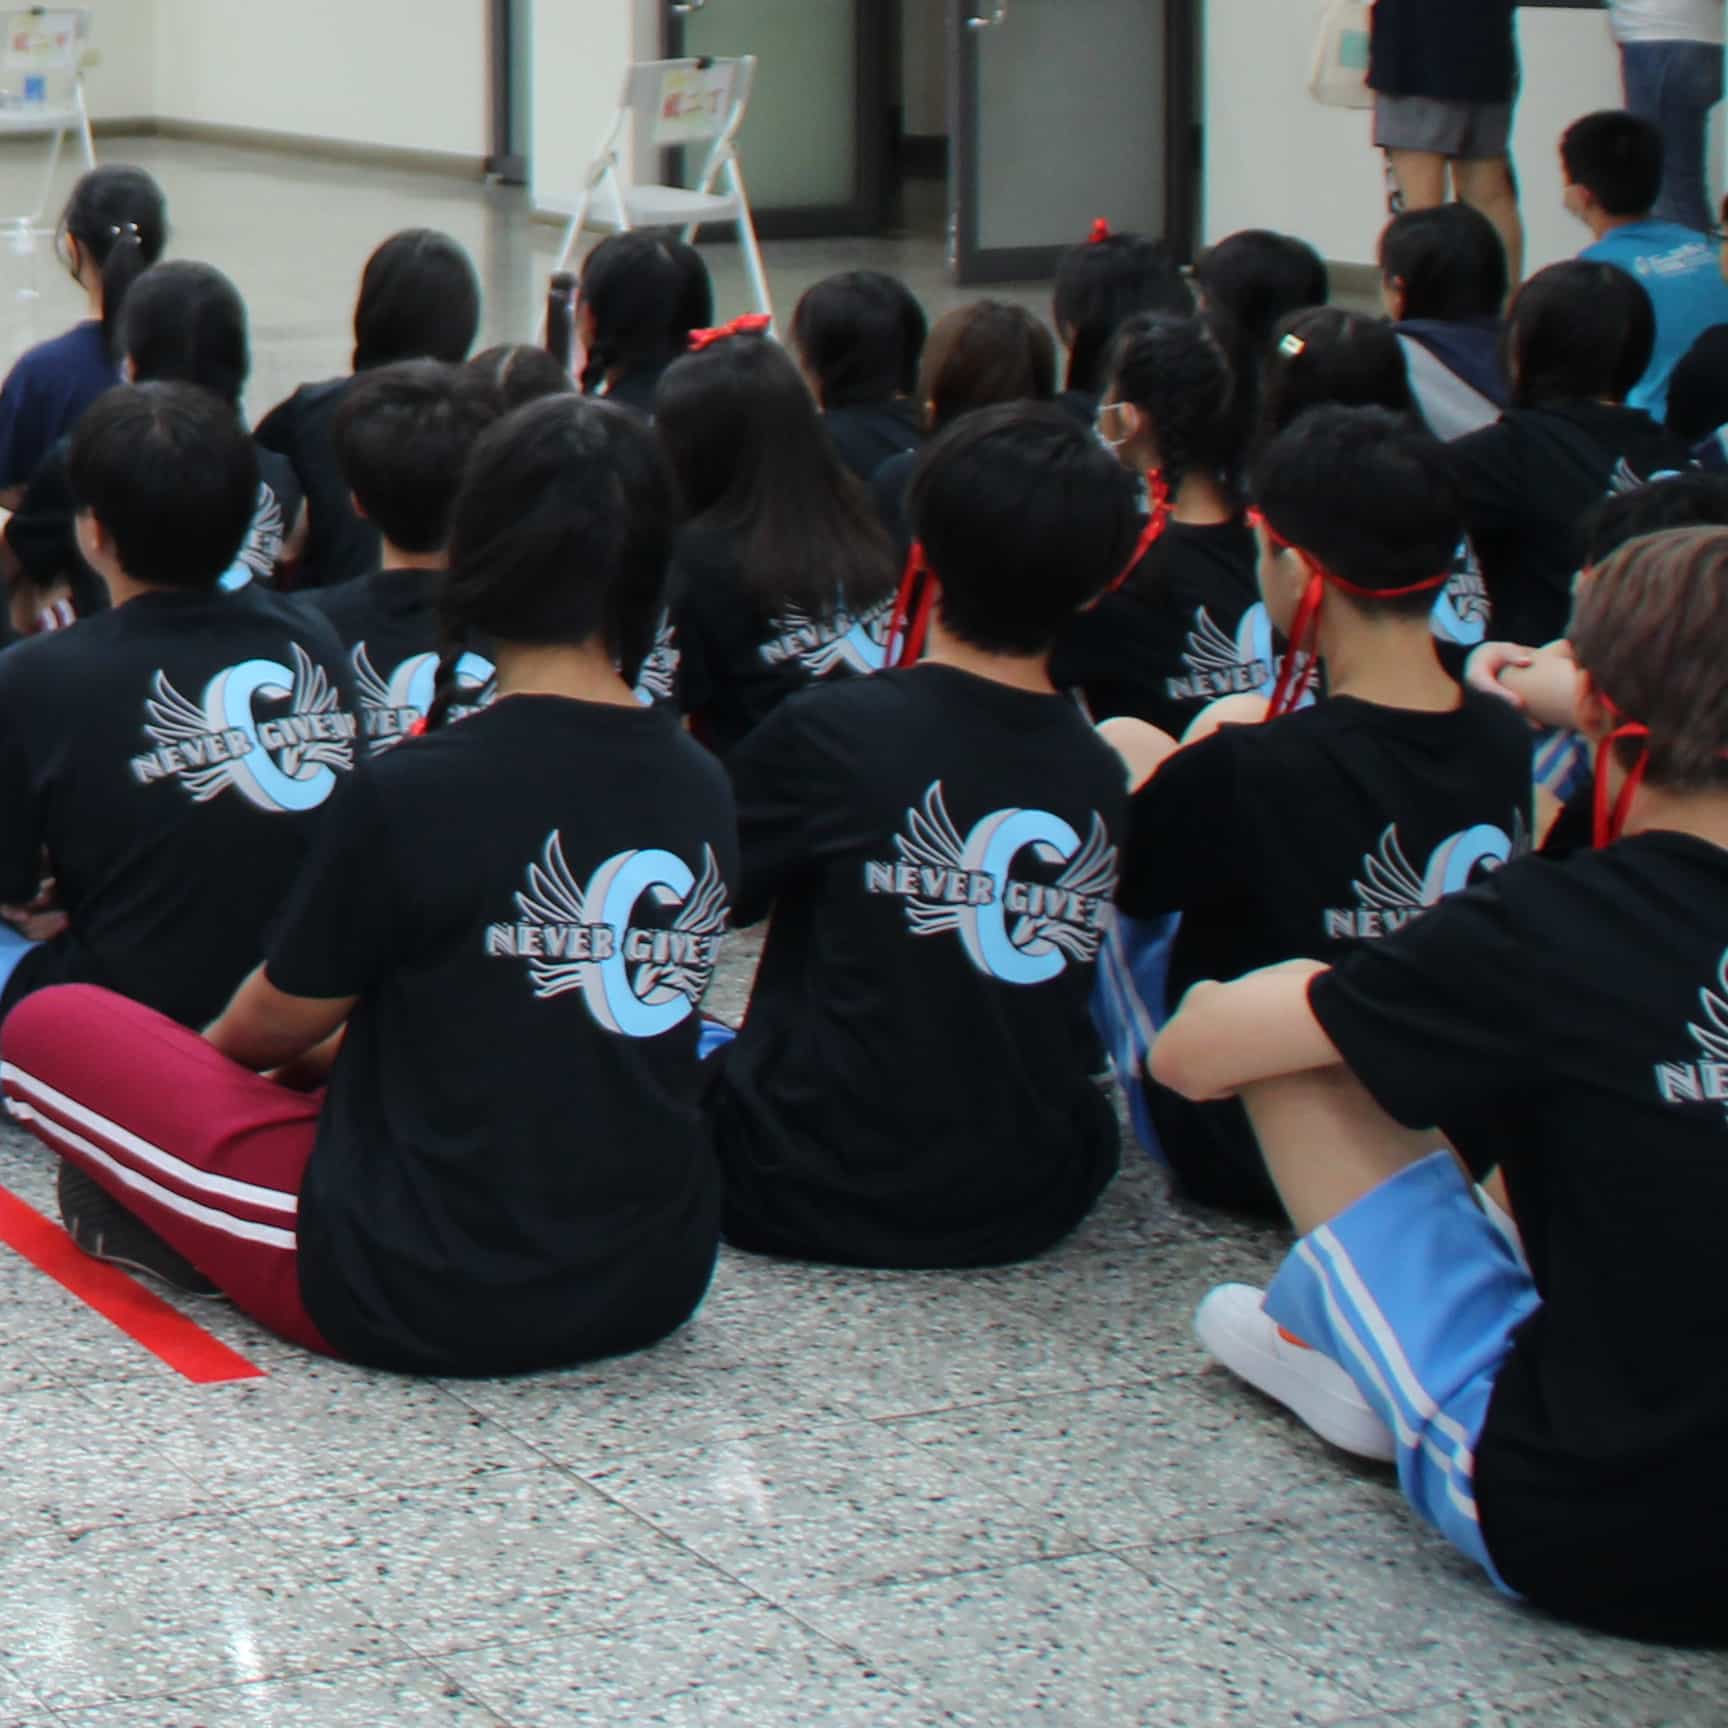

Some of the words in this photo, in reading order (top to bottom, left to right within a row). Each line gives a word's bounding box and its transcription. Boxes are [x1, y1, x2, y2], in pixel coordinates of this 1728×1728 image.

[130, 727, 253, 785] NEVER
[864, 861, 995, 906] NEVER
[1003, 880, 1089, 925] GIVE
[485, 922, 614, 961] NEVER
[623, 927, 706, 965] GIVE
[1323, 906, 1426, 940] NEV
